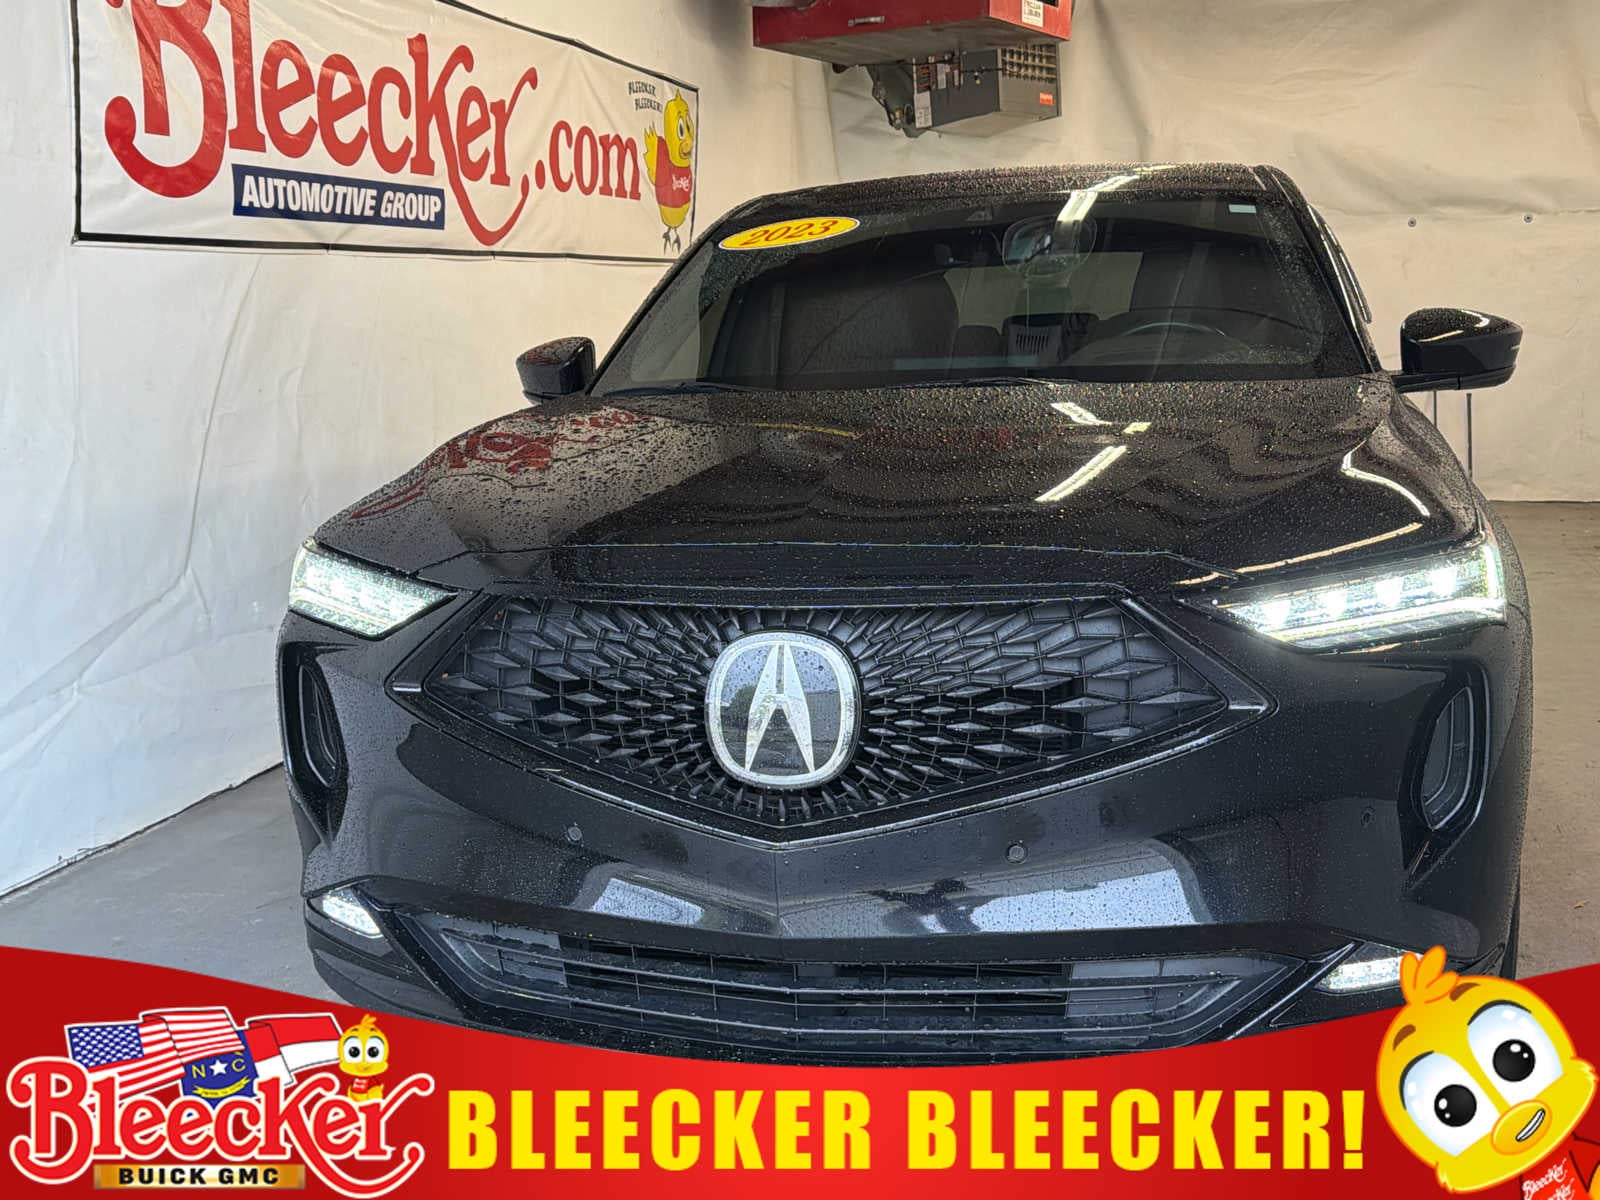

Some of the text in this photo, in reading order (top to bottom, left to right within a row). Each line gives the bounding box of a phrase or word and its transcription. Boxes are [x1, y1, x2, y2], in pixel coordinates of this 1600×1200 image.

[241, 174, 442, 222] AUTOMOTIVE GROUP
[740, 219, 838, 246] 2023
